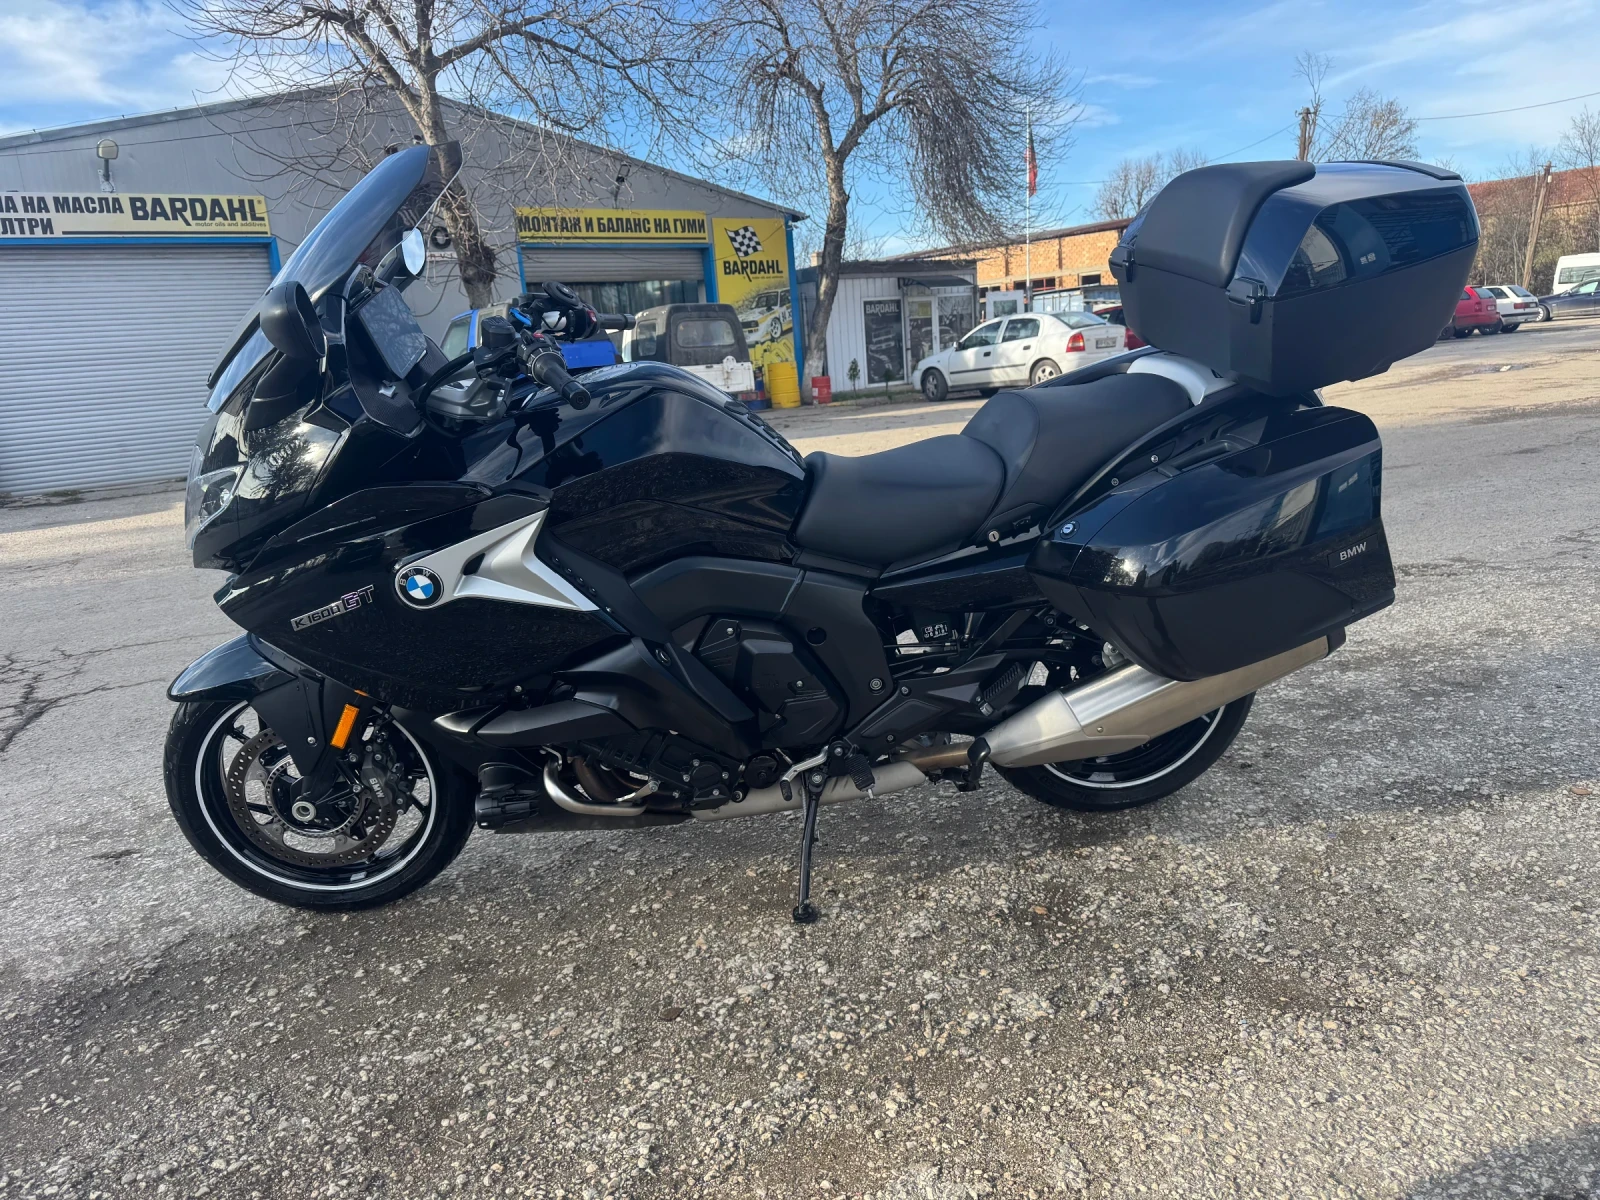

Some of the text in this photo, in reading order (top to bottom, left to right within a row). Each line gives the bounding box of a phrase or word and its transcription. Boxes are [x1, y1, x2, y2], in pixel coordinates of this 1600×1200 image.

[21, 196, 50, 213] НА
[53, 196, 124, 214] МАСЛА
[129, 197, 265, 226] BARDAHL
[517, 216, 706, 234] МОНТАЖ И БАЛАНС НА ГУМИ
[723, 259, 783, 282] BARDAHL
[865, 303, 899, 317] BARDAHL
[1339, 542, 1367, 561] BMW
[369, 777, 385, 798] BMW
